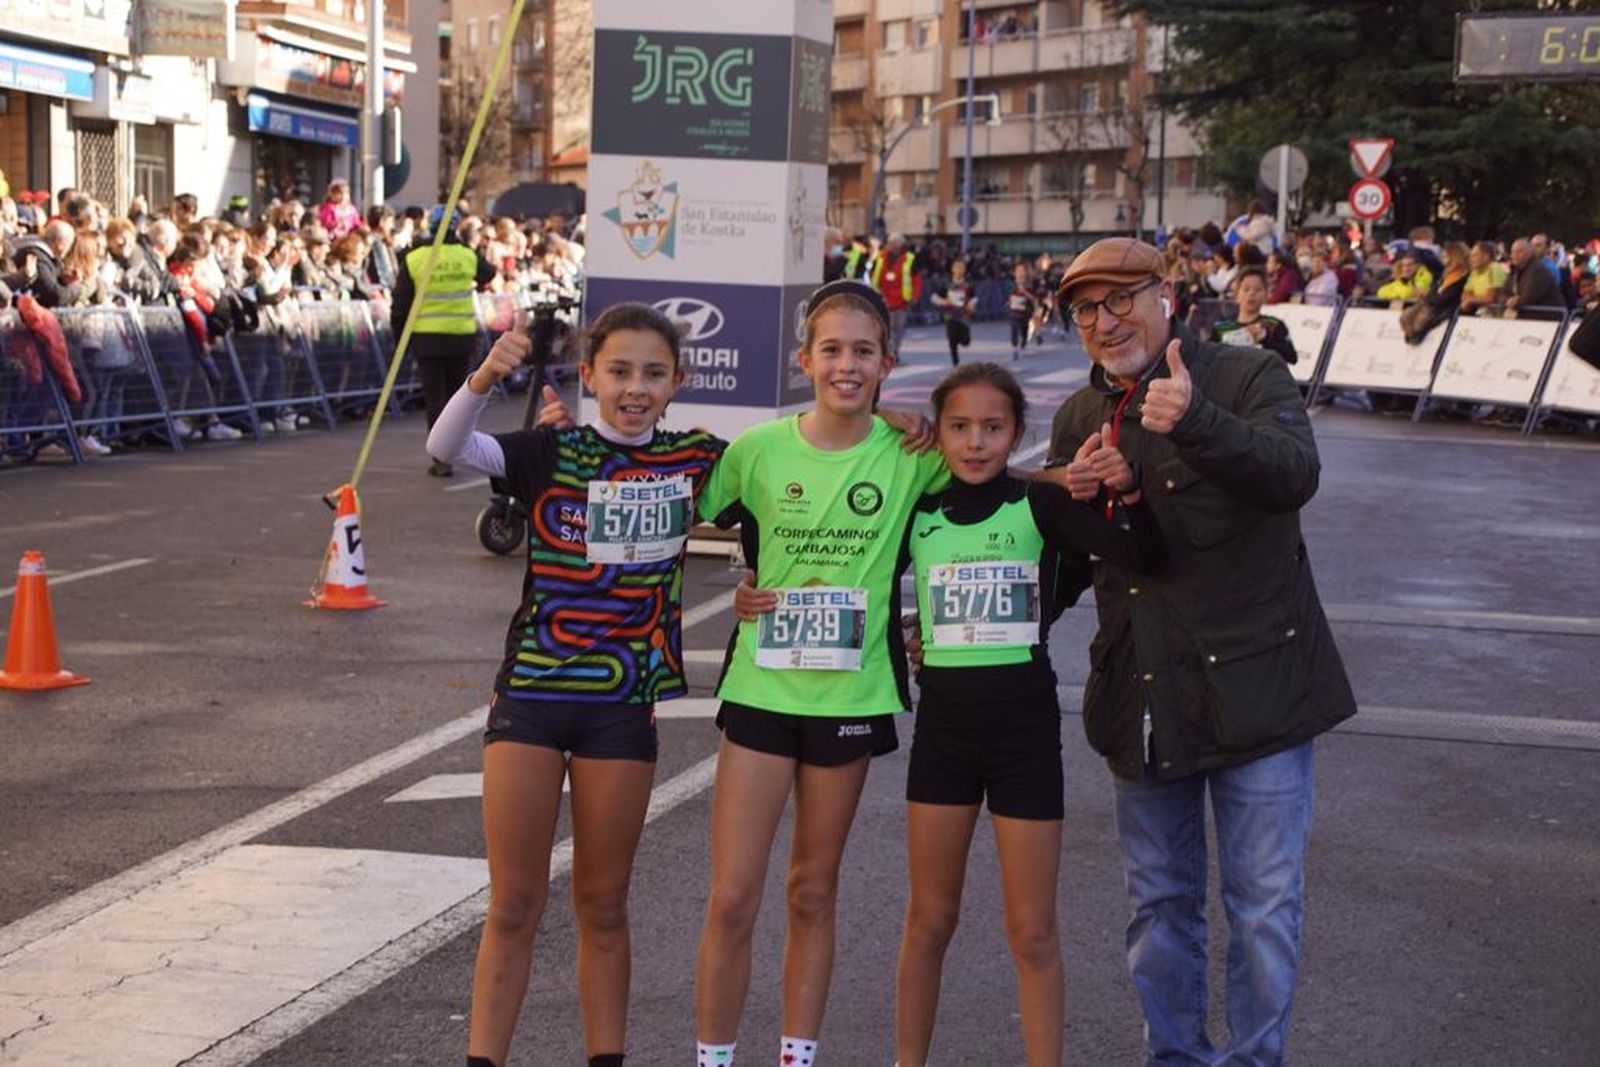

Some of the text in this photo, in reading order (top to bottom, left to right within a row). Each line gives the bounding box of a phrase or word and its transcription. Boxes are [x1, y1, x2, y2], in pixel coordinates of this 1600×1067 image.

[632, 35, 753, 107] JRG
[1359, 191, 1380, 206] 30
[679, 347, 739, 369] NDAI
[620, 483, 682, 501] SETEL
[560, 505, 587, 524] SA
[603, 502, 671, 537] 5760
[560, 525, 588, 543] SA
[957, 566, 1028, 581] SETEL
[787, 592, 856, 606] SETEL
[944, 583, 1012, 618] 5776
[773, 609, 840, 642] 5739
